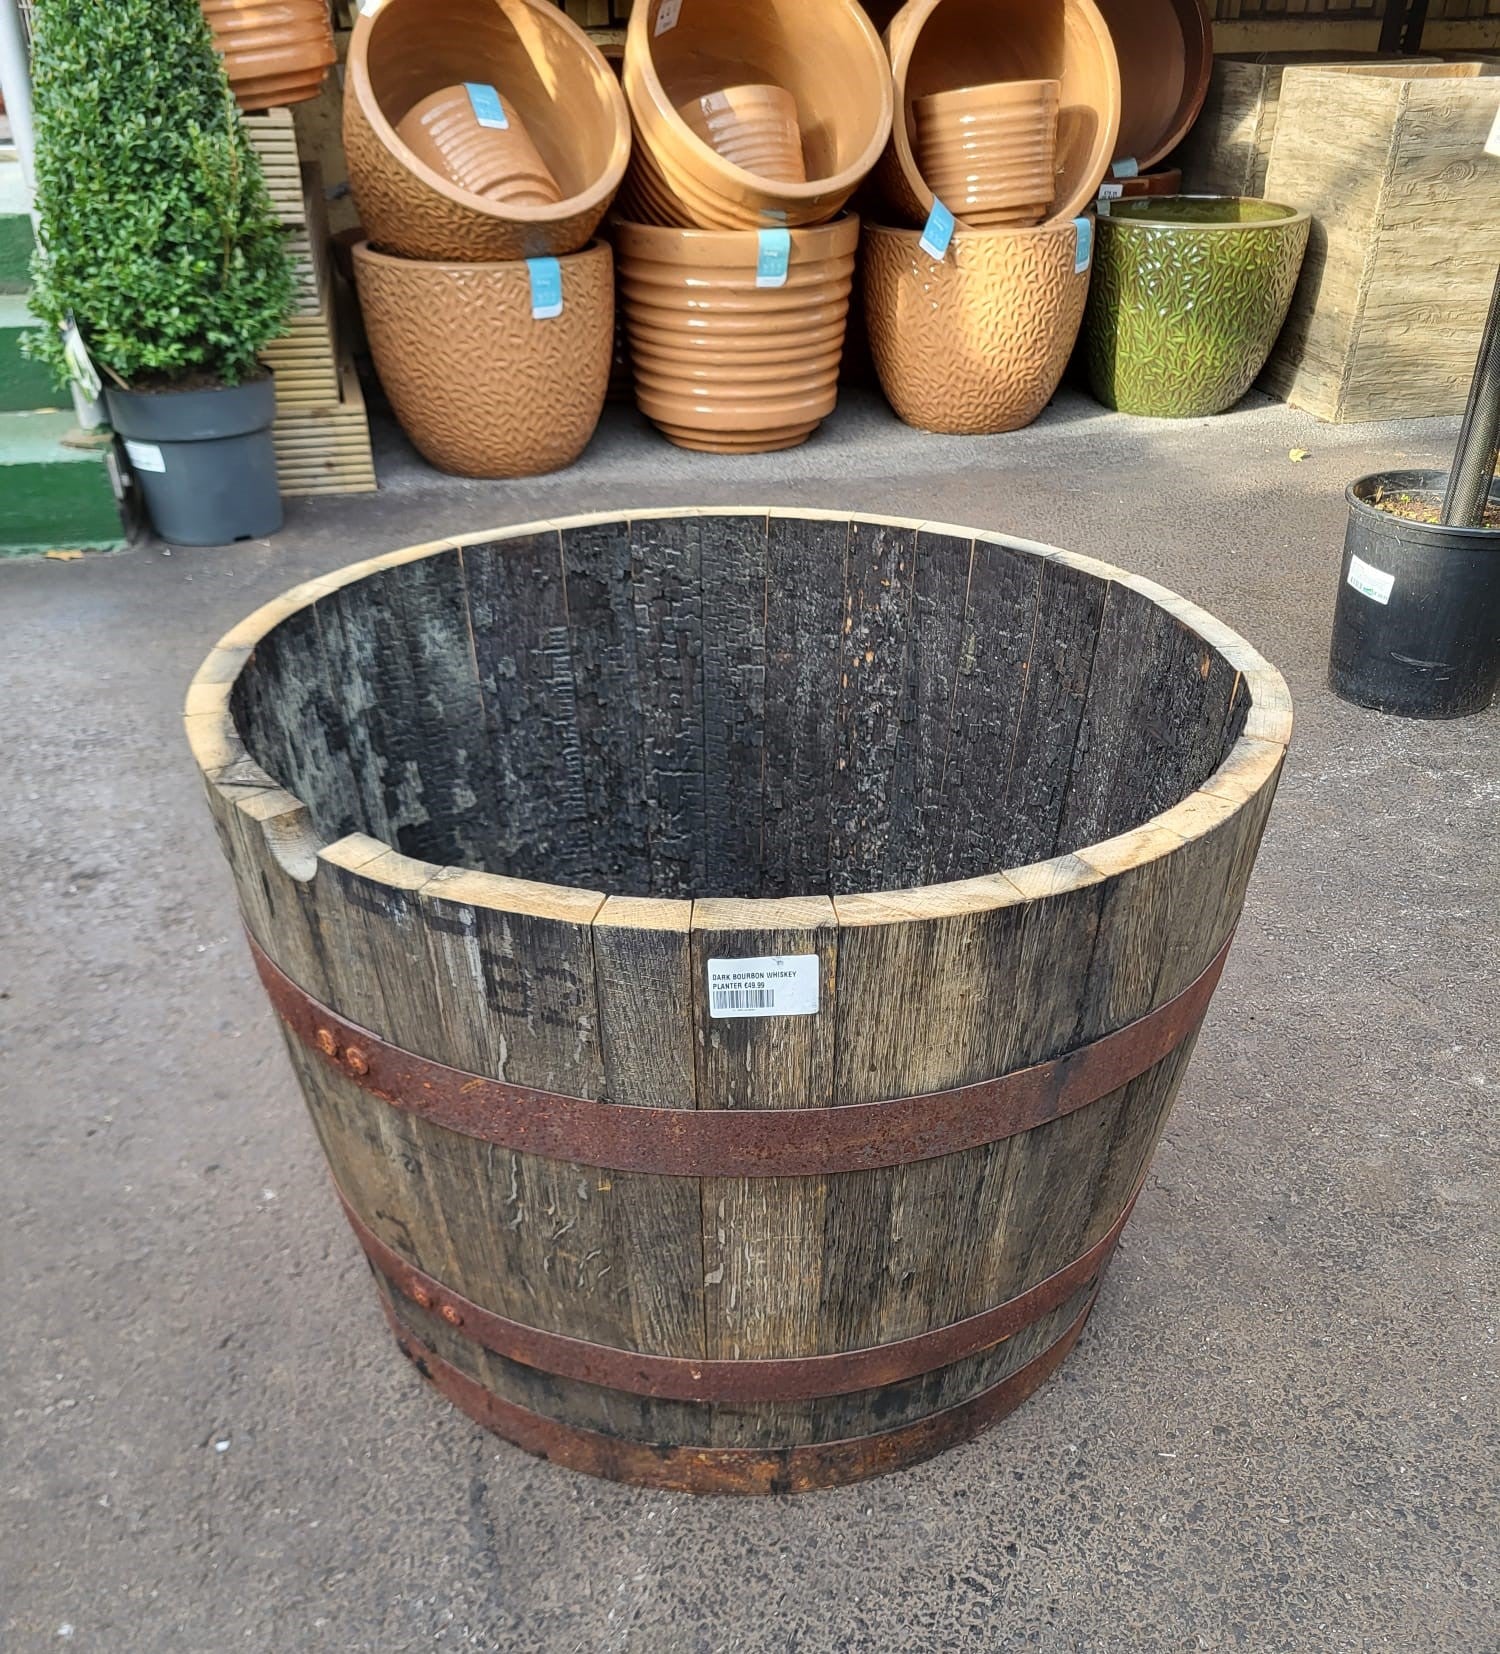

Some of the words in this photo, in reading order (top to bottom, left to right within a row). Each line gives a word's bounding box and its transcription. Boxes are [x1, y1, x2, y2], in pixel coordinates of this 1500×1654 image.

[732, 972, 765, 980] BOURBON
[766, 970, 797, 979] WHISKEY
[712, 982, 742, 990] PLANTER
